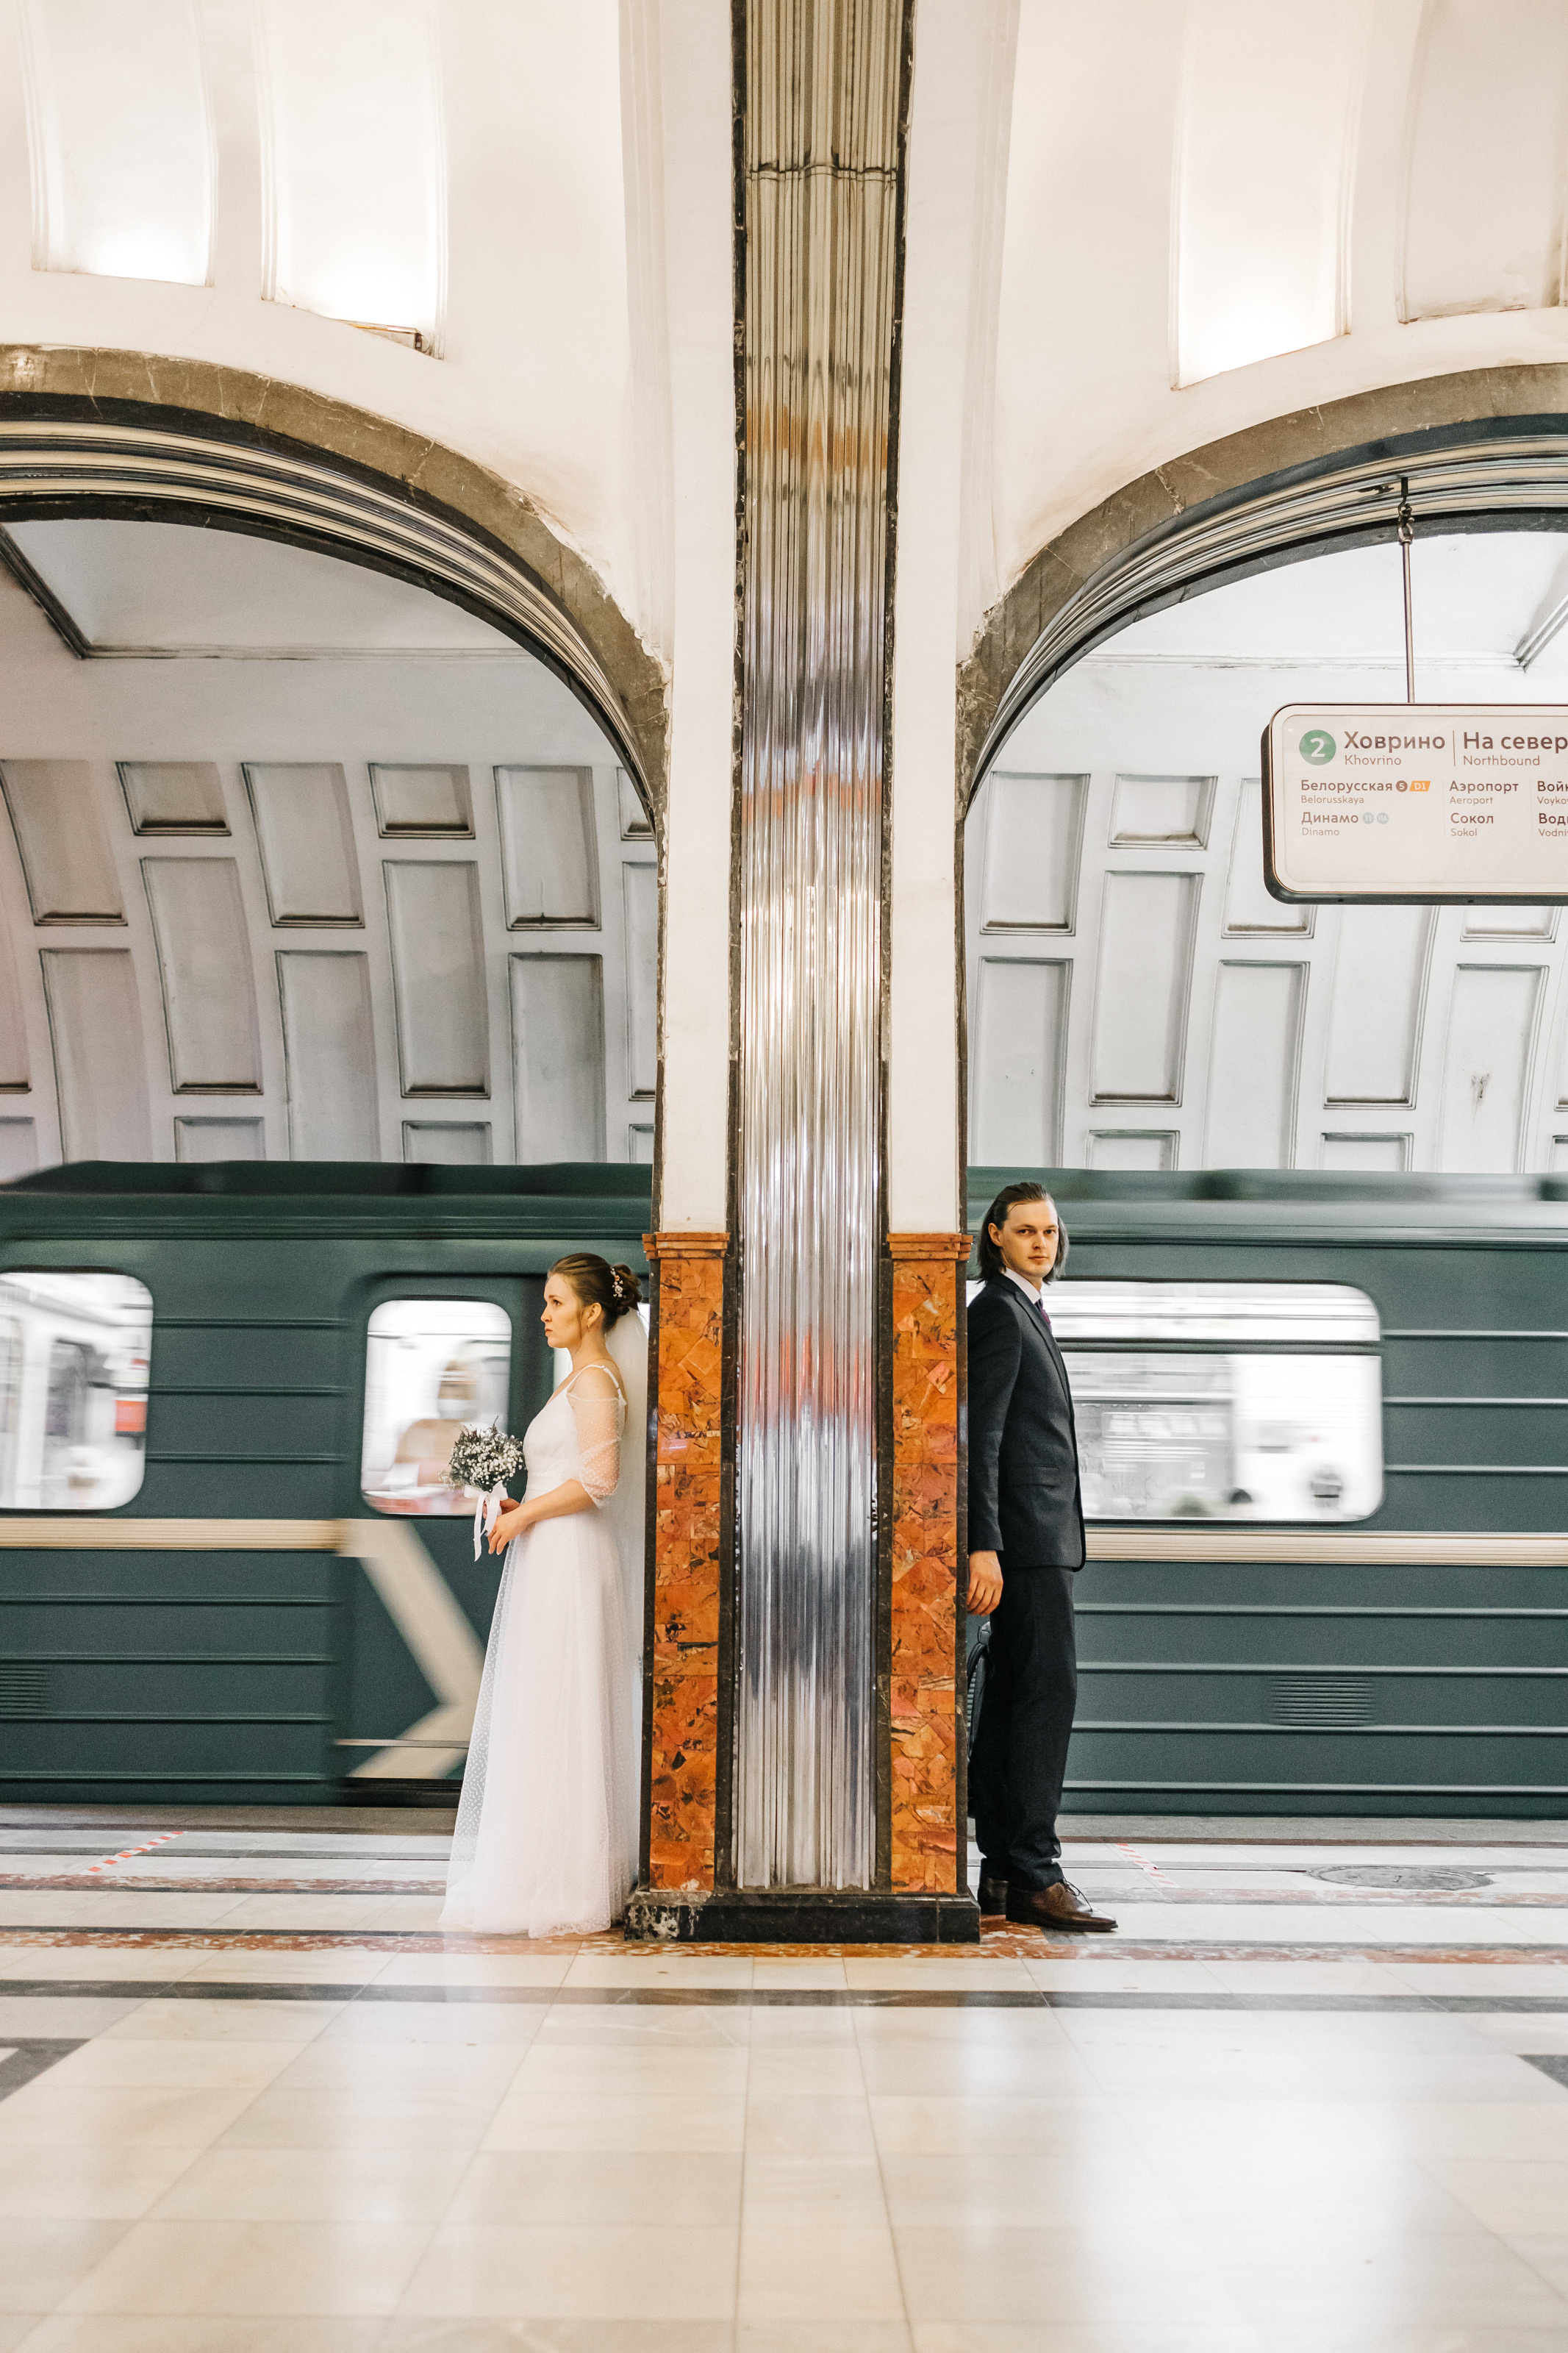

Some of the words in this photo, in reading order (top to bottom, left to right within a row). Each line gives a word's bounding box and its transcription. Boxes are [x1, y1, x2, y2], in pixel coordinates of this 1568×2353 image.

[1310, 738, 1325, 757] 2
[1344, 731, 1445, 753] Ховрино
[1464, 732, 1494, 749] На
[1500, 736, 1568, 754] север
[1345, 754, 1402, 765] Khovrino
[1464, 754, 1540, 765] Northbound
[1300, 779, 1393, 794] Белорусская
[1399, 782, 1405, 790] 5
[1414, 782, 1427, 790] D1
[1449, 780, 1519, 794] Аэропорт
[1301, 795, 1364, 805] Belorusskaya
[1450, 796, 1493, 806] Aeroport
[1301, 812, 1358, 825] Динамо
[1450, 813, 1494, 824] Сокол
[1539, 813, 1568, 826] Вод
[1302, 827, 1340, 836] Dinamo
[1450, 828, 1478, 837] Sokol
[1538, 828, 1568, 837] Vodni
